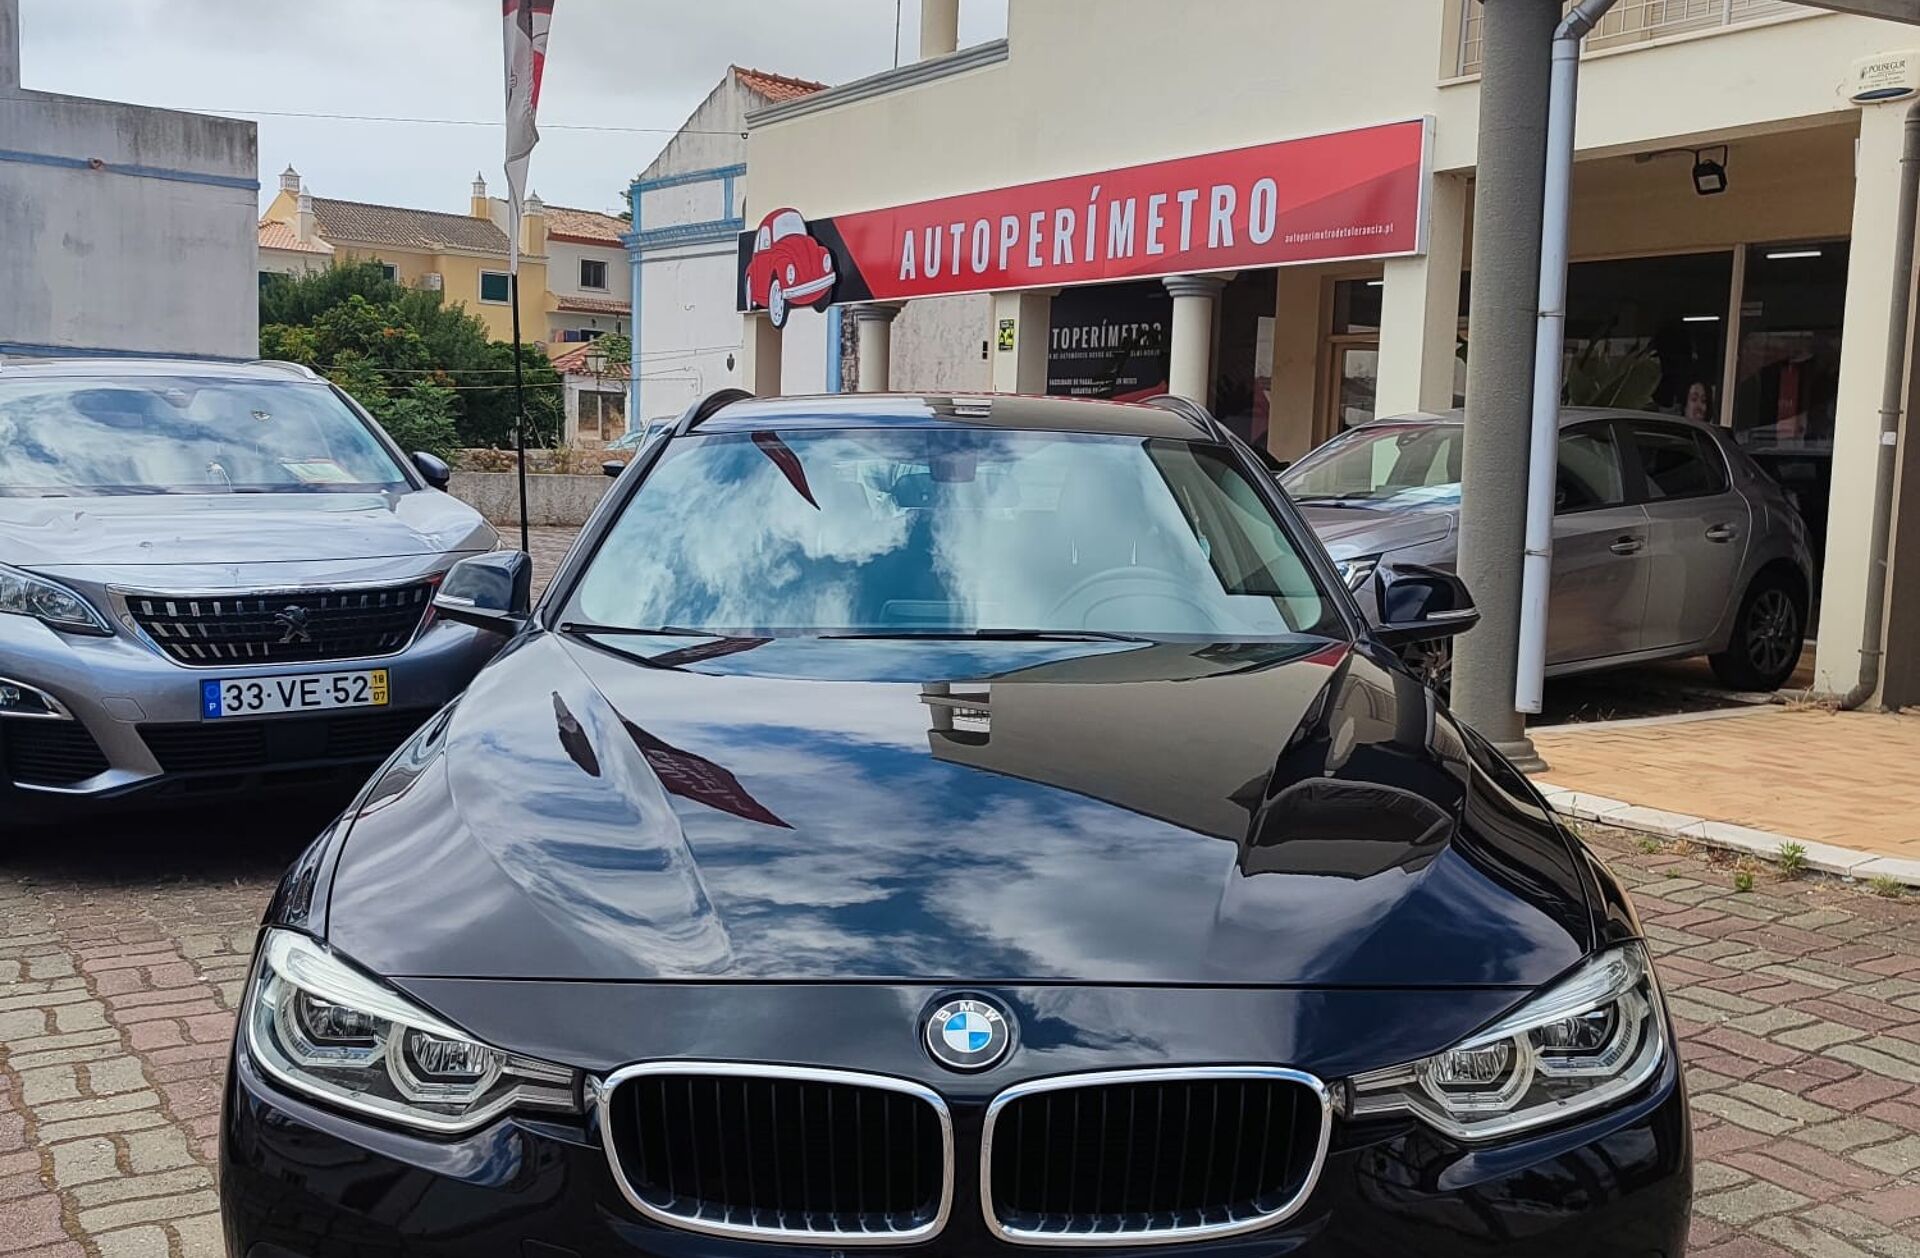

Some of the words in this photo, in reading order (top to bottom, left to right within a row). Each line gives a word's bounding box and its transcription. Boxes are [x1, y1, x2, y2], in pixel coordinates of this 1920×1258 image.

[899, 177, 1278, 281] AUTOPERÍMETRO
[373, 691, 386, 701] 07
[208, 702, 217, 711] P
[936, 1002, 1001, 1022] BMW
